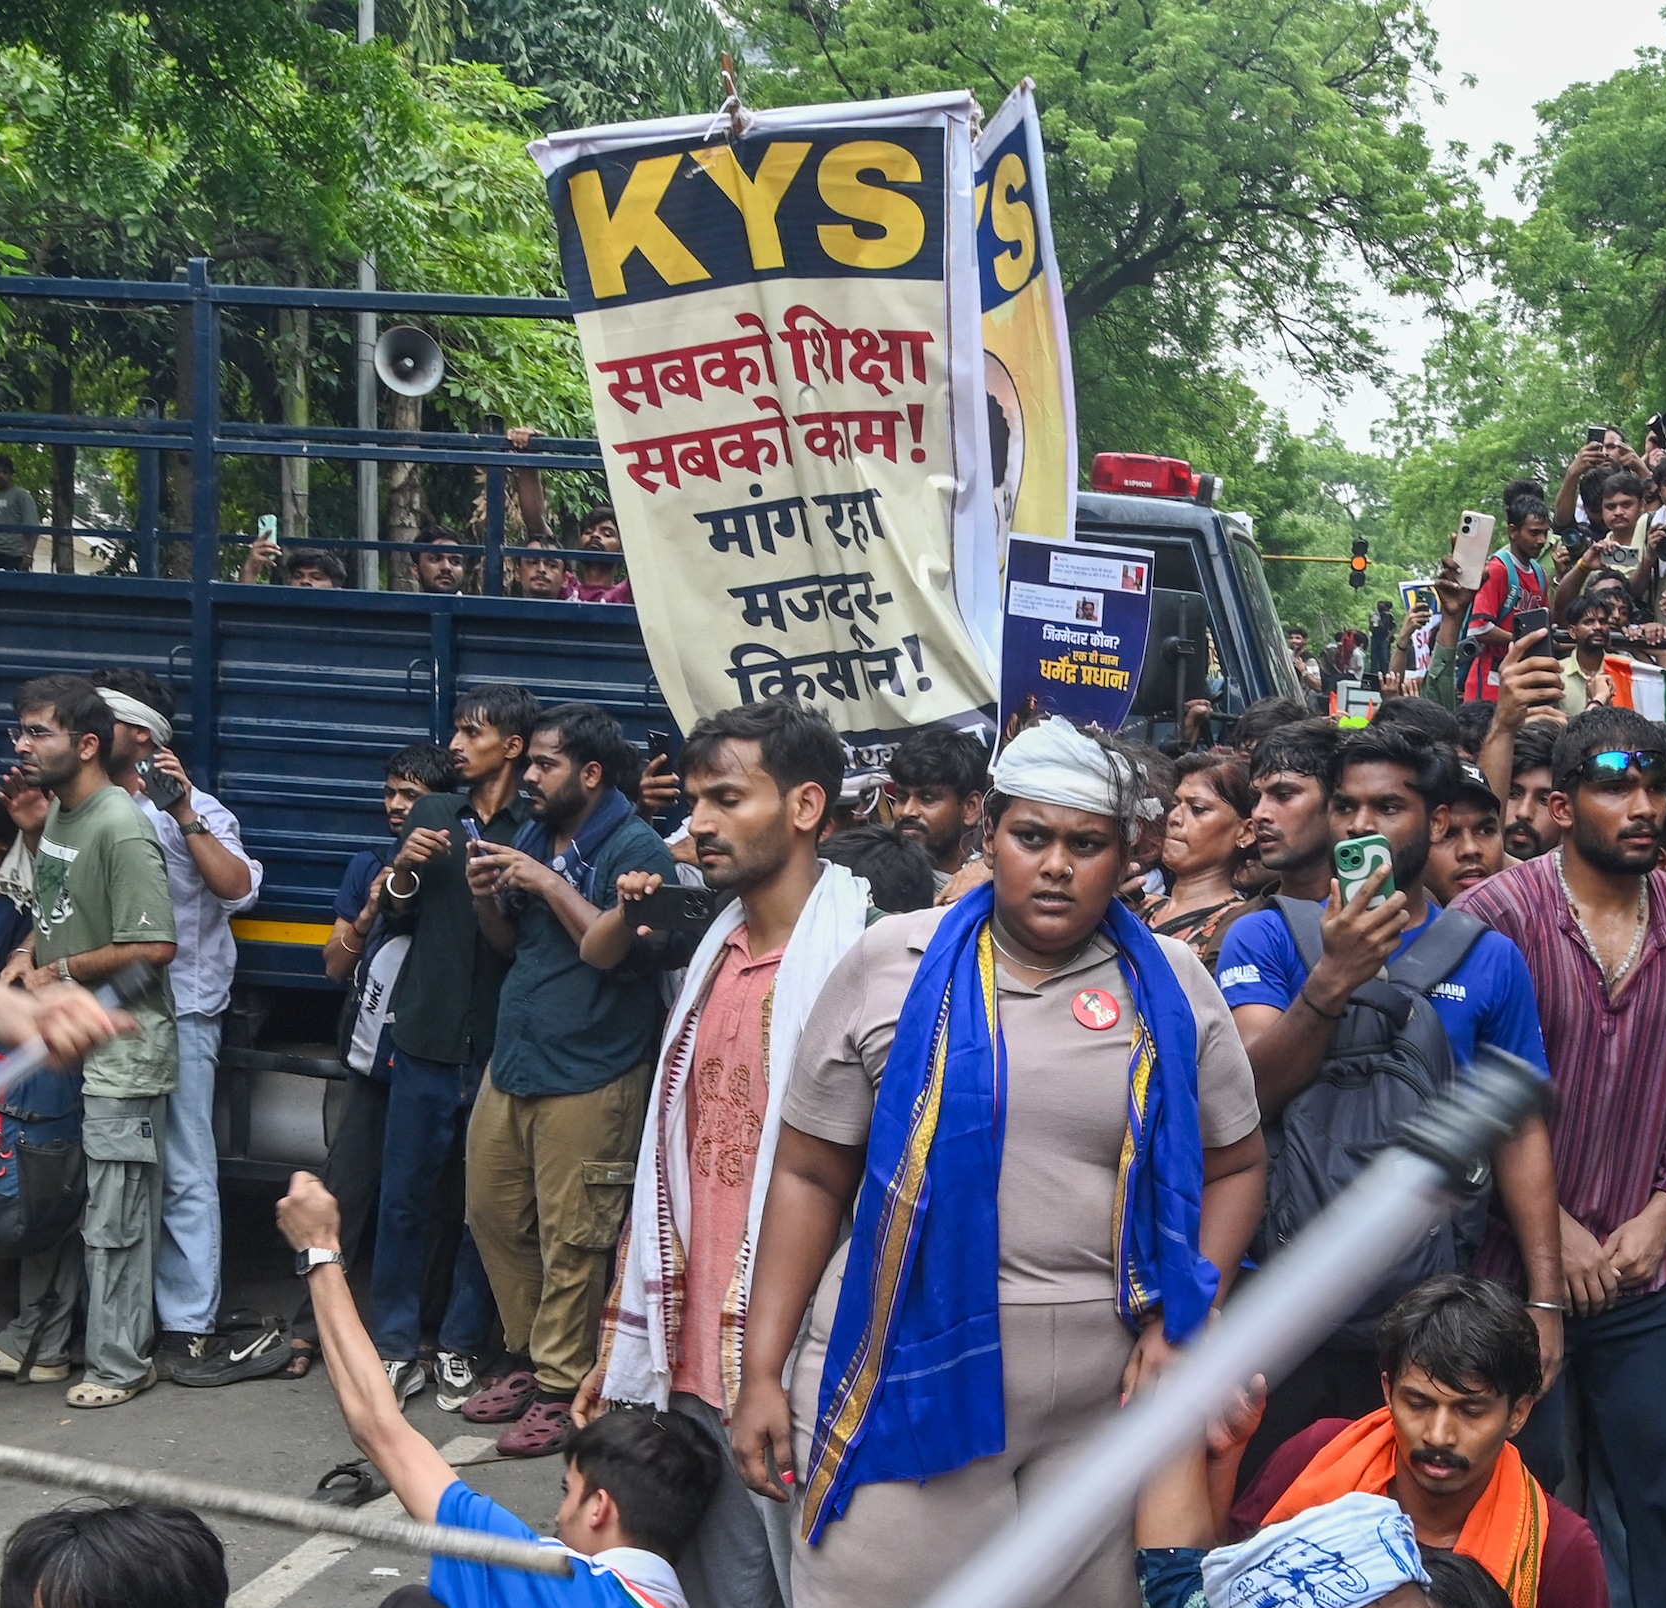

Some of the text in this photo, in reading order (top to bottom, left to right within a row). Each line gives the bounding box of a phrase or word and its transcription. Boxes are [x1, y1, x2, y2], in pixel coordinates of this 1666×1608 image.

[569, 141, 925, 299] KYS
[595, 305, 935, 414] सबको शिक्षा
[612, 396, 926, 494] सबको काम!
[693, 483, 885, 559] मांग रहा
[724, 634, 932, 706] किसान!
[1042, 624, 1120, 650] जिम्मेदार कौन?
[1100, 654, 1120, 667] नाम
[1081, 665, 1130, 691] प्रधान!
[365, 980, 384, 1015] NIKE
